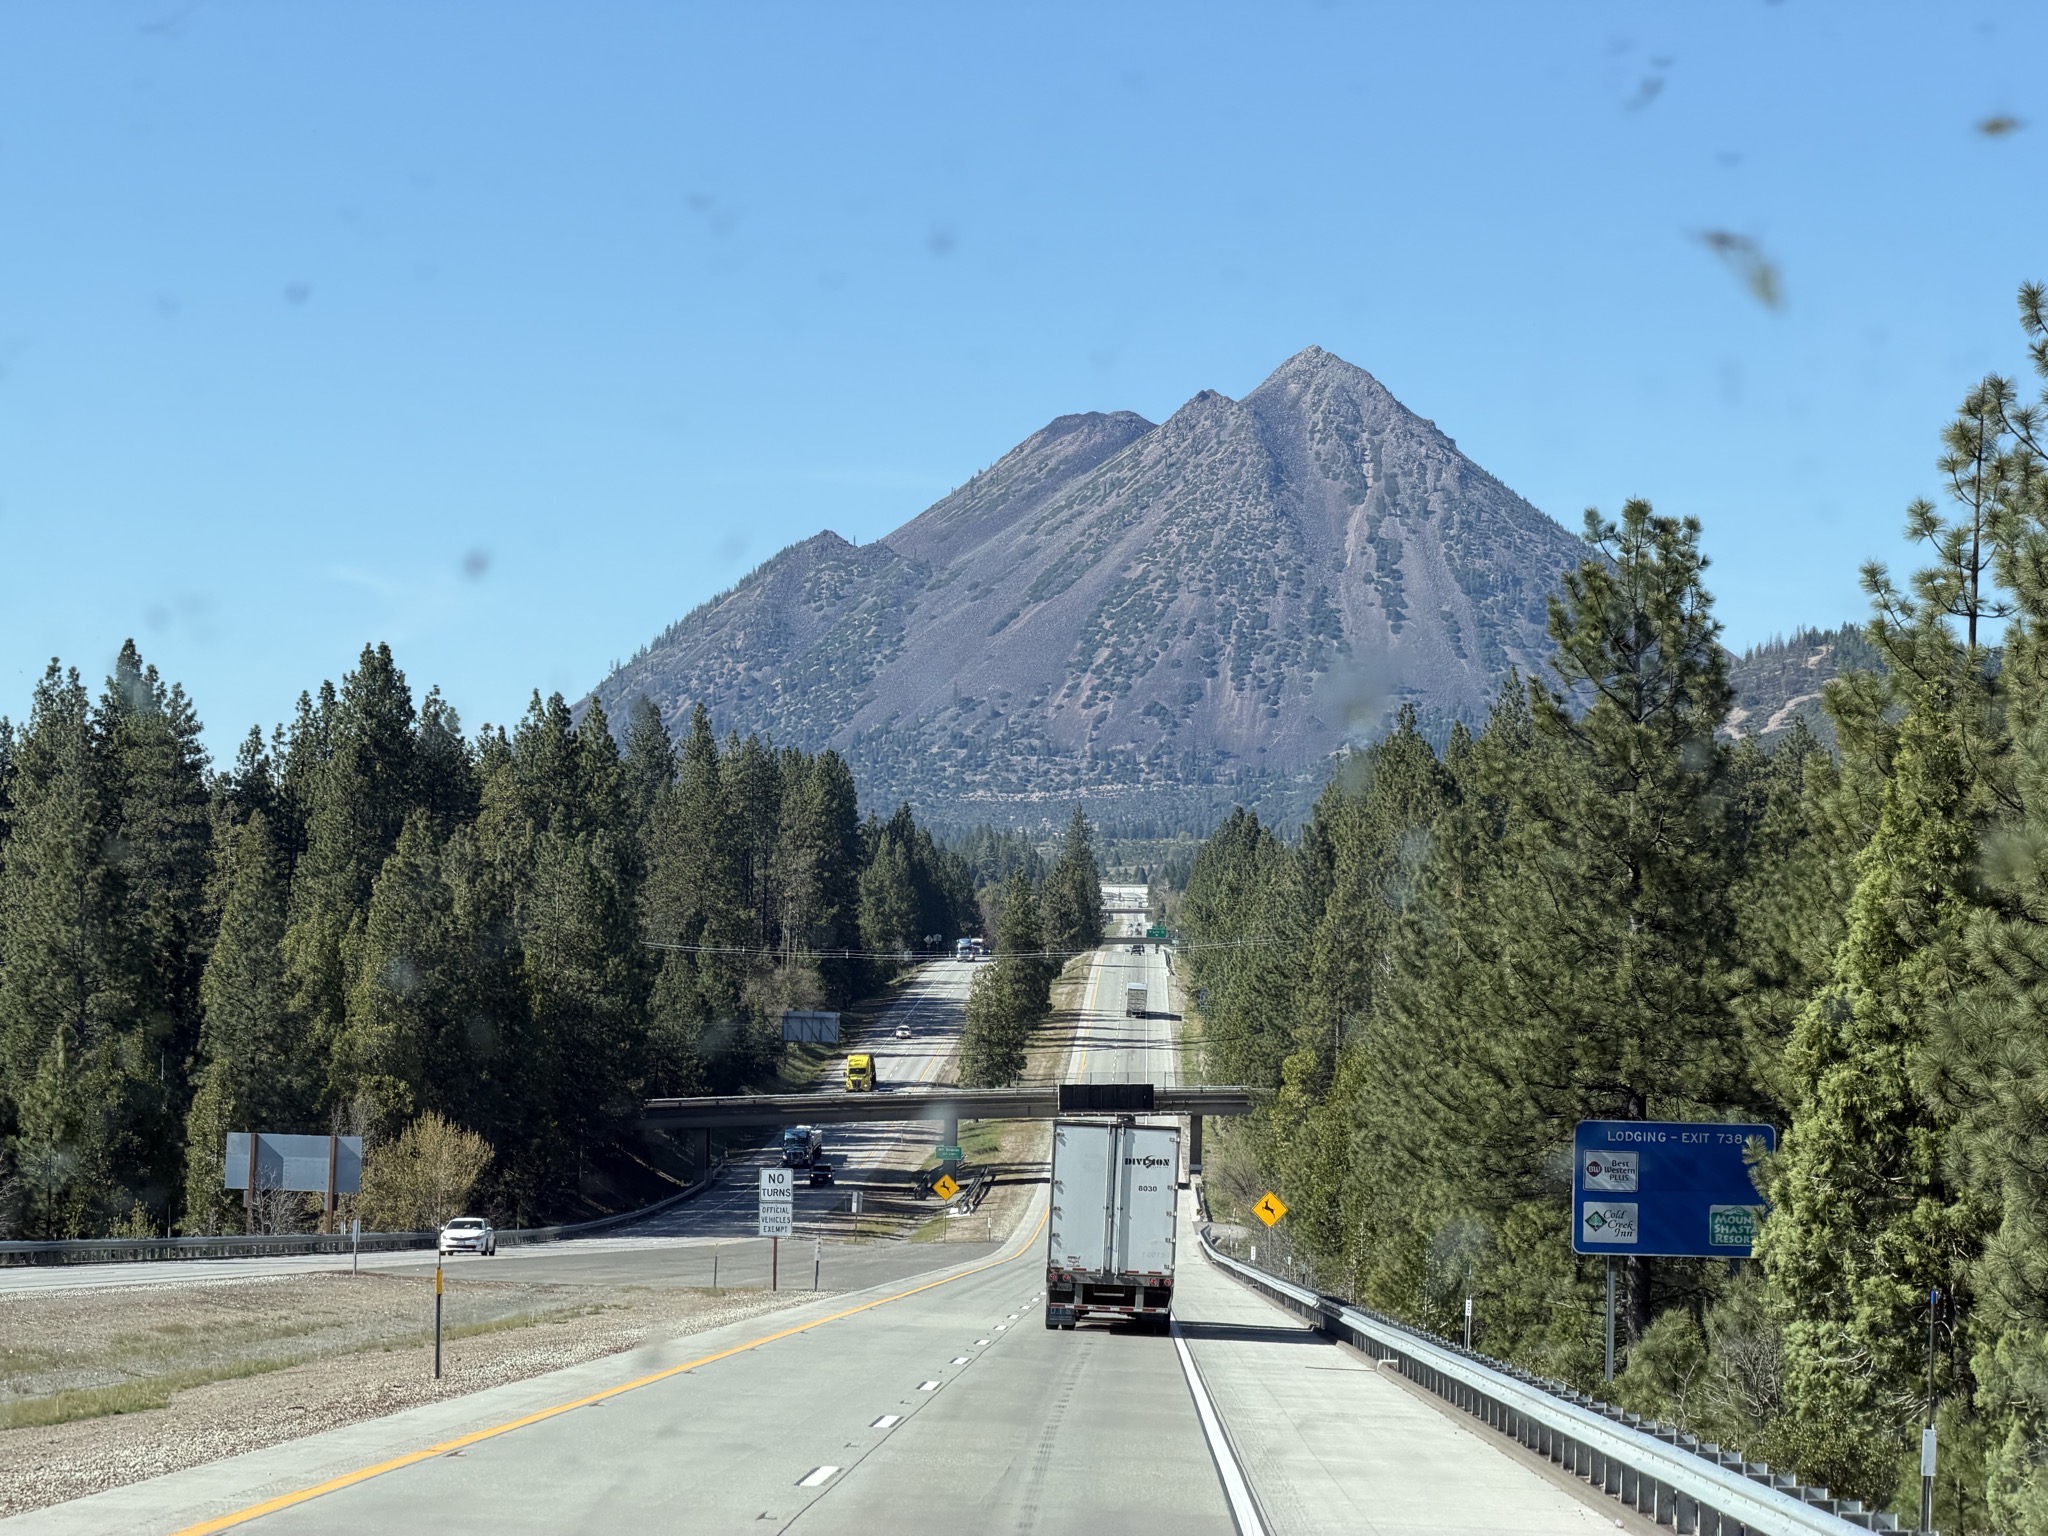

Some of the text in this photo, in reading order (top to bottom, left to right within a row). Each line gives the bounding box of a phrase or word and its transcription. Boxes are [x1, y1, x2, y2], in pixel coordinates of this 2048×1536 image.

[1607, 1131, 1667, 1143] LODGING
[1681, 1132, 1710, 1143] EXIT
[1717, 1134, 1743, 1144] 738
[1604, 1166, 1635, 1174] Western
[768, 1174, 784, 1184] NO
[762, 1189, 791, 1197] TURNS
[1603, 1209, 1626, 1219] Cold
[1714, 1214, 1752, 1224] MOUN
[761, 1216, 791, 1224] VEHICLES
[1607, 1219, 1636, 1231] Creek
[1614, 1228, 1633, 1237] Inn
[1714, 1223, 1757, 1234] SHASTA
